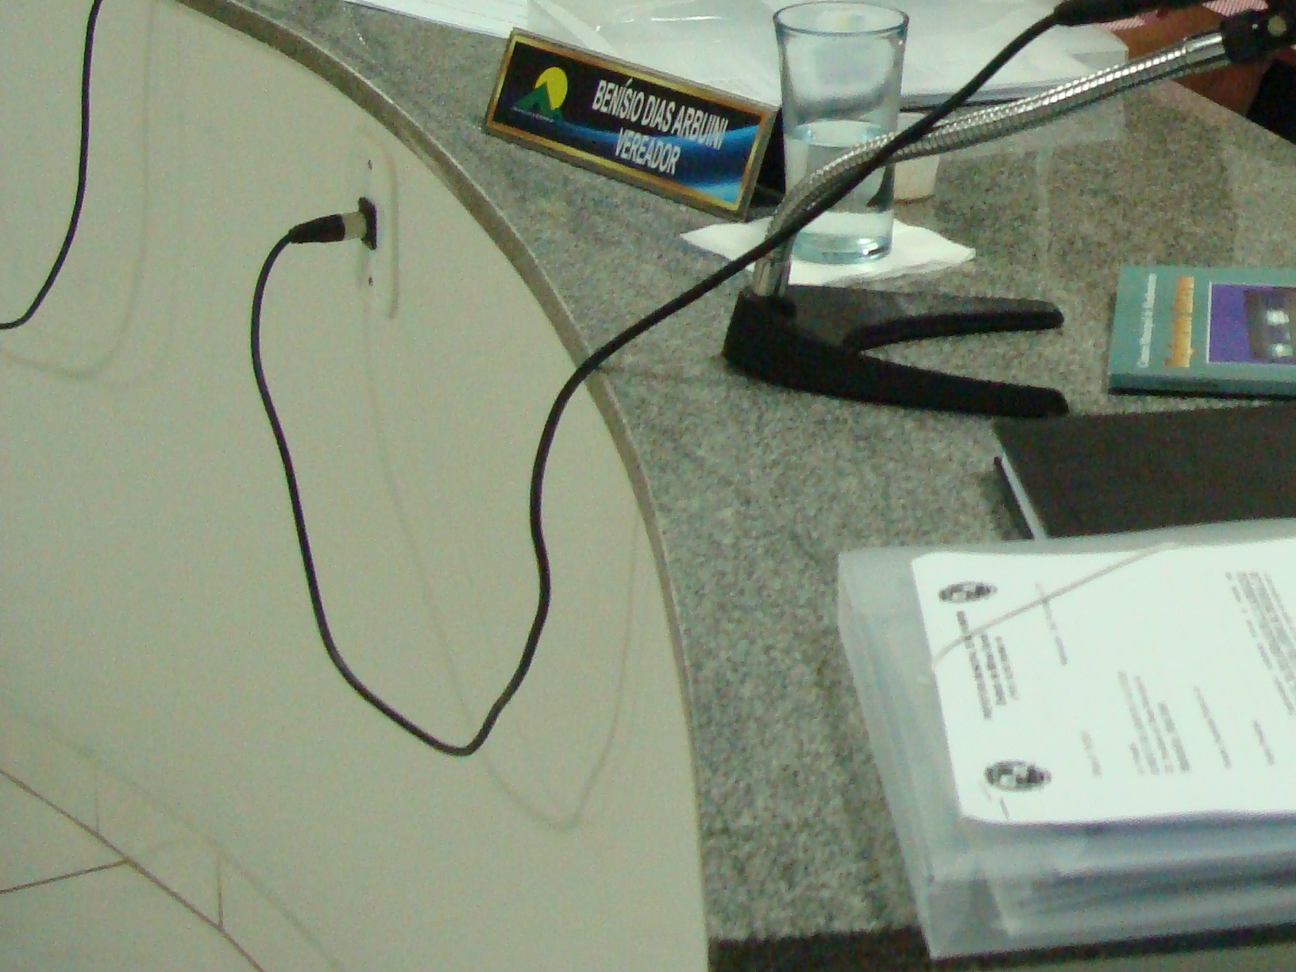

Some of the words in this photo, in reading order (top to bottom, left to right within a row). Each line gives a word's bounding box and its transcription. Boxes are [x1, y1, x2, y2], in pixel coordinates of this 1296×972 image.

[592, 77, 645, 123] BENÍSIO
[641, 95, 676, 132] DIAS
[671, 105, 729, 150] ARBUINI
[615, 127, 681, 176] VEREADOR
